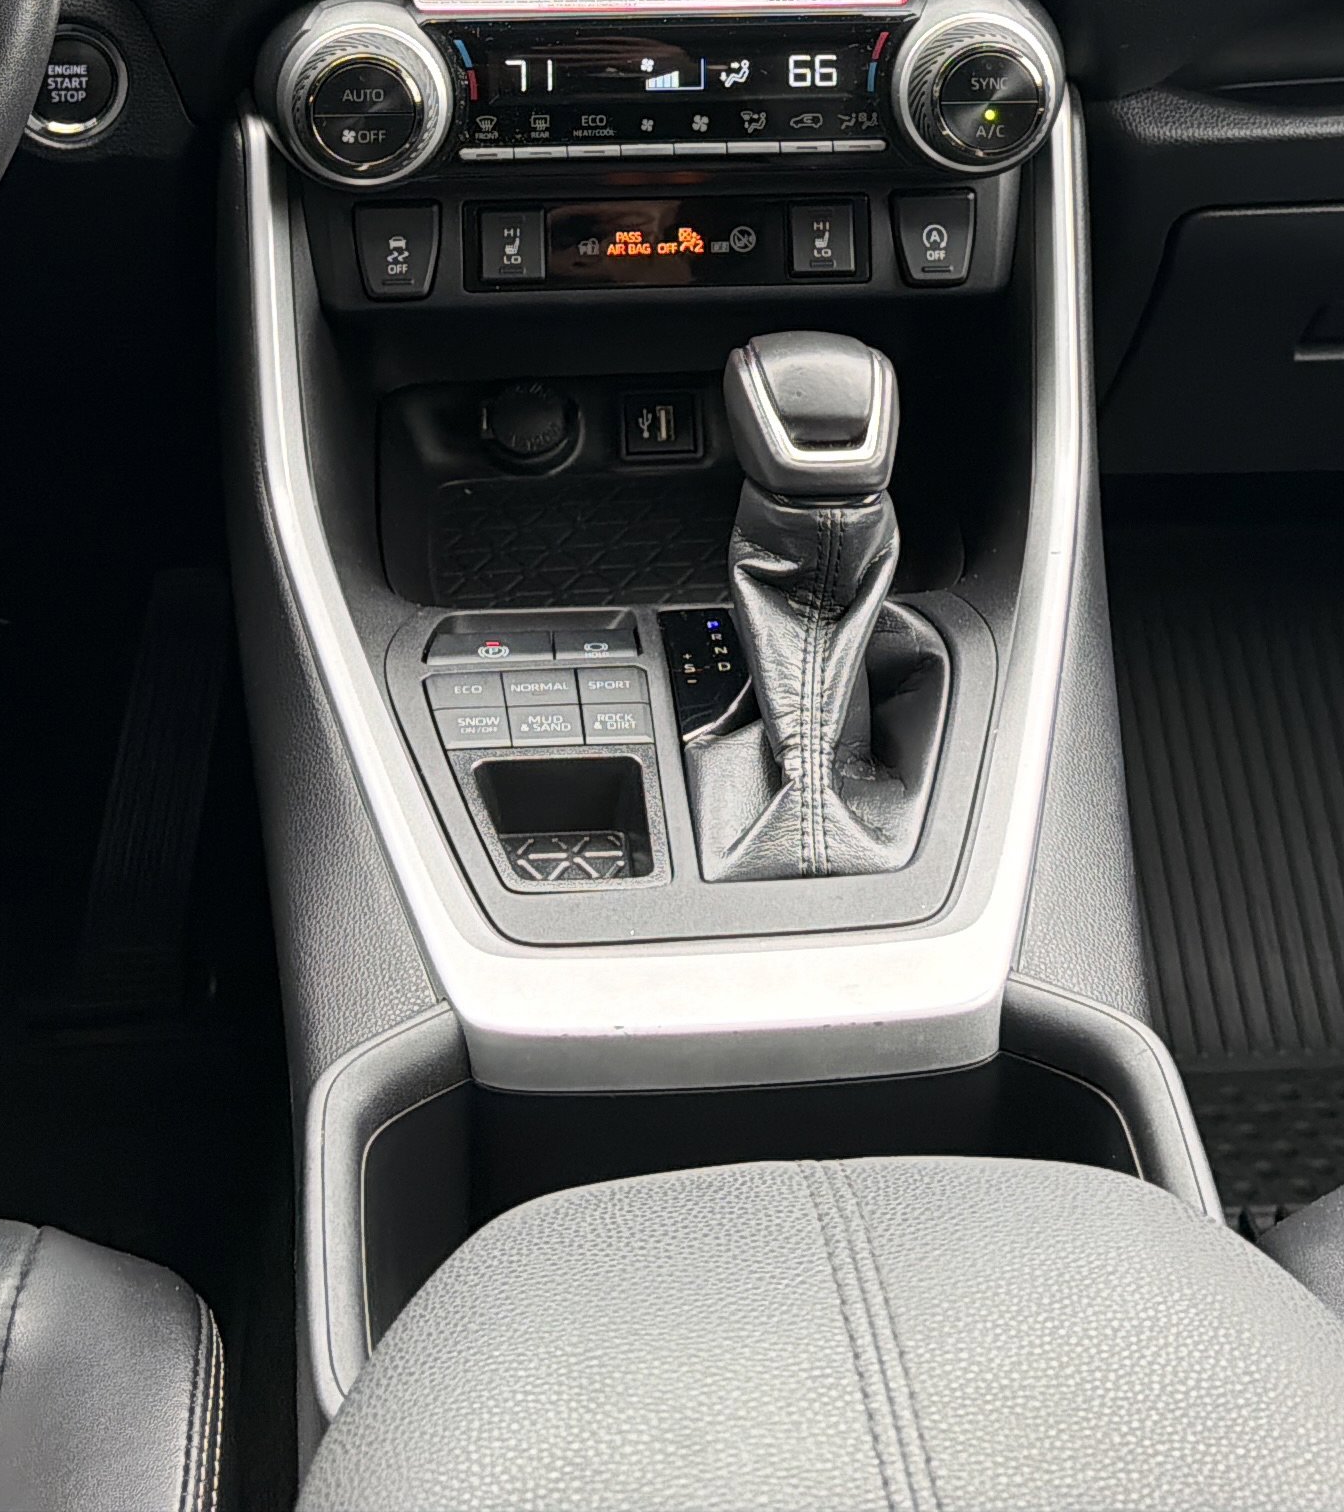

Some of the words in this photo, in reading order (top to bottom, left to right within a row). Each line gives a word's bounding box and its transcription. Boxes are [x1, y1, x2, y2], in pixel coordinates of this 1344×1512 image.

[48, 65, 88, 75] ENGINE
[788, 54, 837, 87] 66
[505, 59, 553, 92] 71
[47, 77, 88, 89] START
[970, 76, 1009, 90] SYNC
[51, 91, 86, 103] STOP
[342, 89, 385, 102] AUTO
[581, 115, 607, 126] ECO
[975, 123, 1005, 138] A/C
[357, 130, 386, 144] OFF
[813, 222, 829, 231] HI
[504, 228, 520, 237] HI
[615, 231, 642, 243] PASS
[607, 243, 626, 255] AIR
[627, 242, 652, 255] BAG
[657, 242, 678, 254] OFF
[813, 249, 831, 258] LO
[503, 255, 522, 265] LO
[926, 250, 947, 261] OFF
[387, 264, 408, 275] OFF
[718, 662, 731, 671] D
[454, 685, 483, 694] ECO
[510, 682, 569, 693] NORMAL
[588, 680, 631, 690] SPORT
[457, 716, 500, 726] SNOW
[528, 715, 563, 724] MUD
[597, 713, 634, 722] ROCK
[460, 726, 498, 734] ON/OFF
[520, 723, 530, 732] &
[532, 722, 572, 732] SAND
[593, 721, 603, 730] &
[606, 720, 638, 730] DIRT
